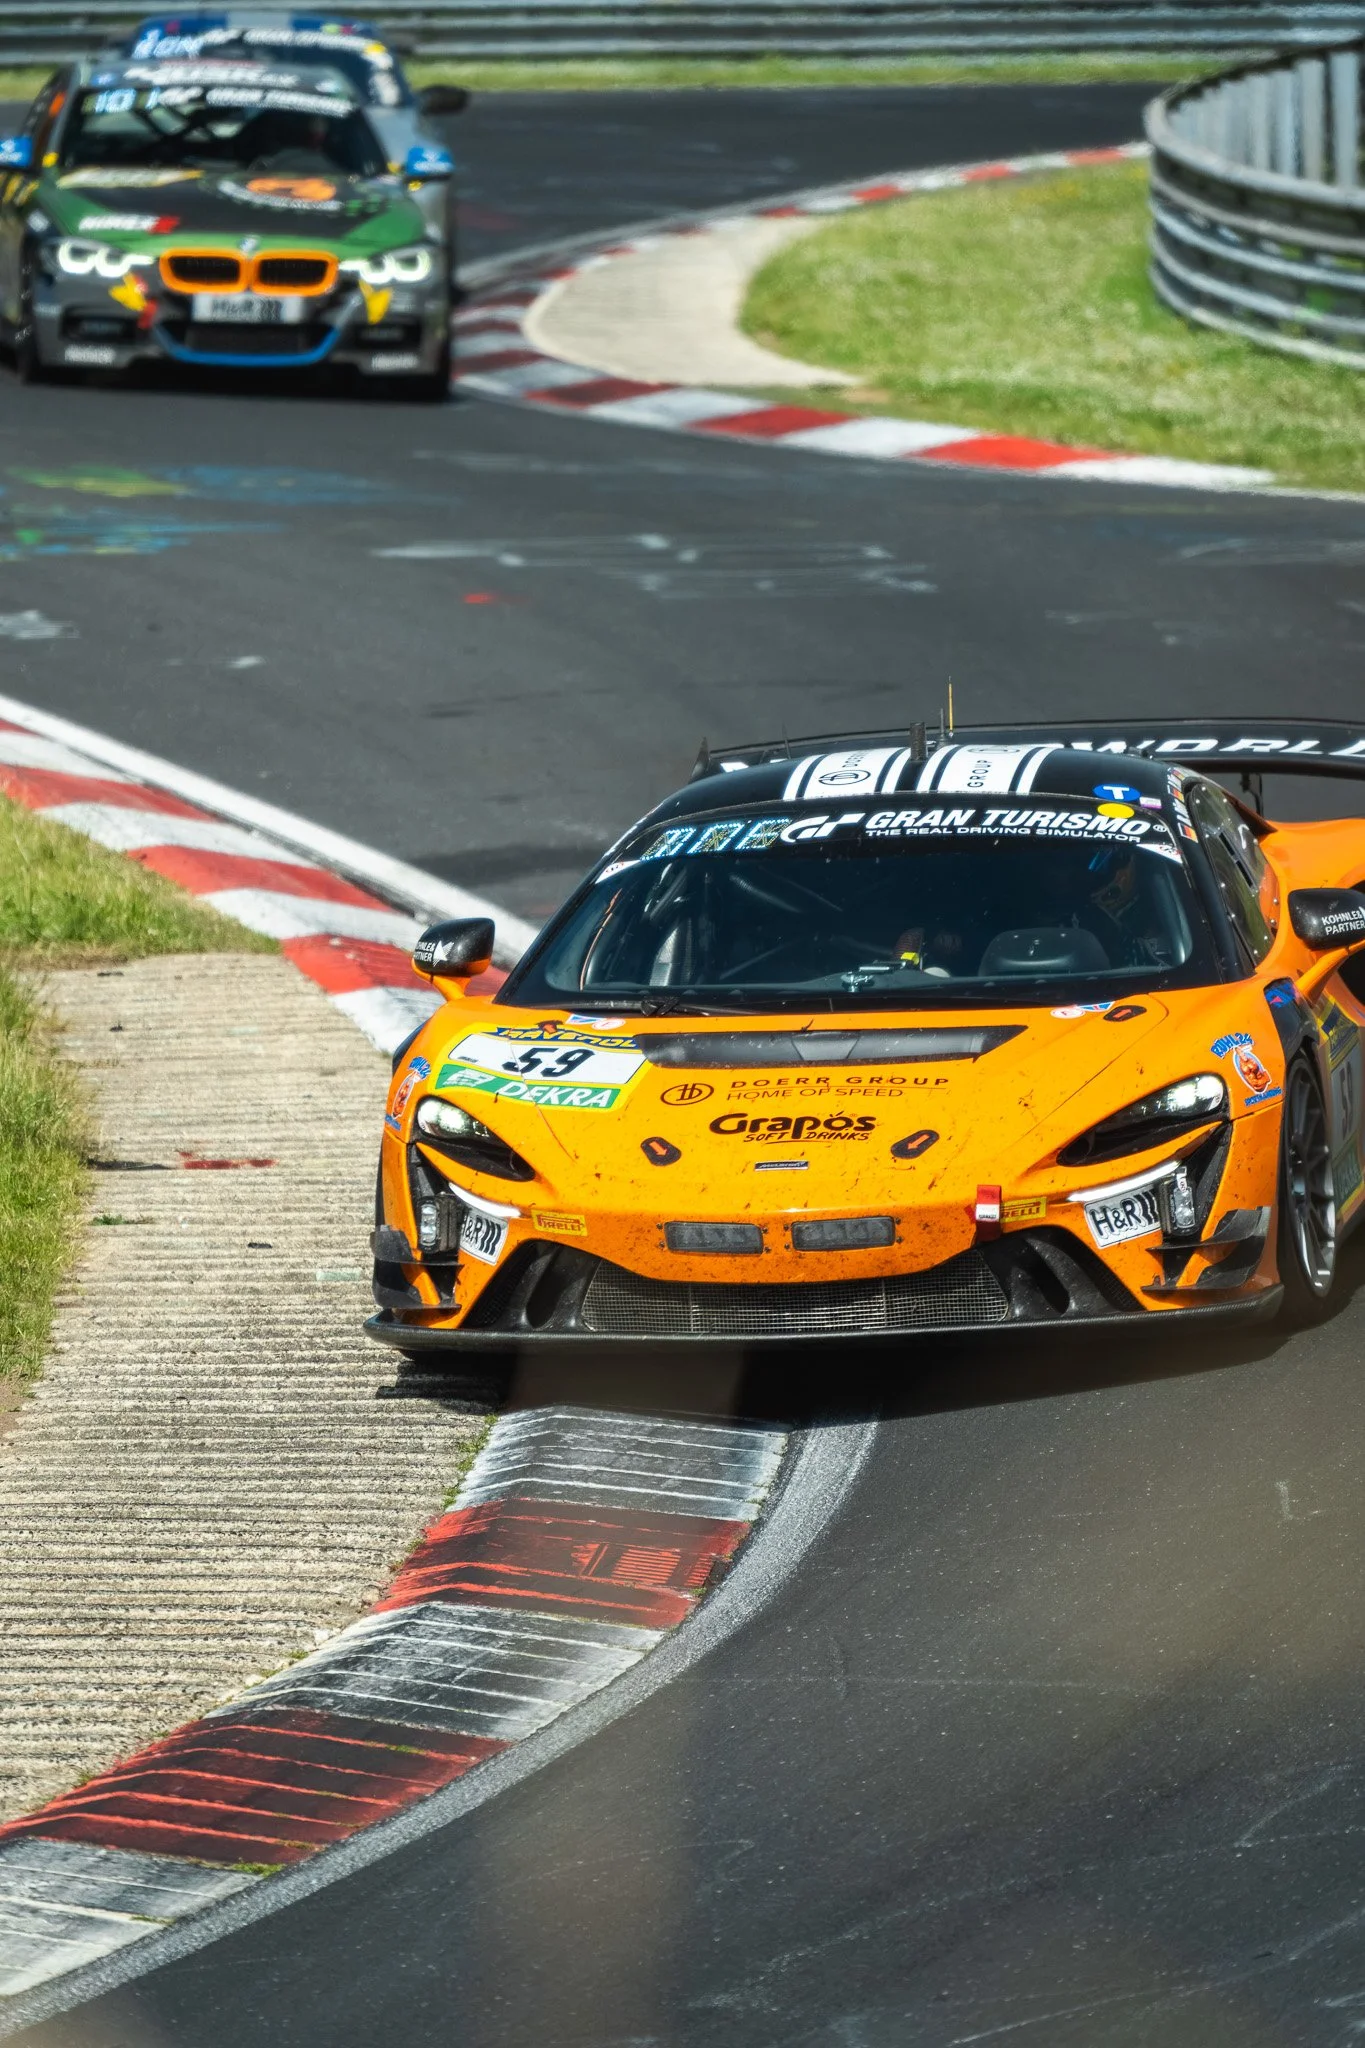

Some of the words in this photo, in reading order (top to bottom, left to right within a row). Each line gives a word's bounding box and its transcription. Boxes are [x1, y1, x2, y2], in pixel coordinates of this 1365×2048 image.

[967, 760, 992, 788] GROUP
[865, 809, 978, 829] GRAN
[983, 809, 1151, 836] TURISMO
[865, 827, 902, 838] THE
[905, 827, 951, 836] REAL
[956, 826, 1030, 836] DRIVING
[1034, 827, 1141, 843] SIMULATOR
[1325, 919, 1365, 936] PARTNER
[497, 1027, 637, 1048] RAVENOL
[501, 1047, 596, 1078] 59
[731, 1076, 831, 1089] DOERR
[846, 1076, 949, 1087] GROUP
[496, 1082, 612, 1108] DEKRA
[726, 1088, 793, 1101] HOME
[799, 1088, 825, 1098] OF
[834, 1088, 904, 1098] SPEED
[743, 1131, 792, 1143] SOFT
[804, 1131, 869, 1141] DRINKS
[536, 1214, 581, 1231] PIRELLI
[1089, 1199, 1143, 1238] H&R
